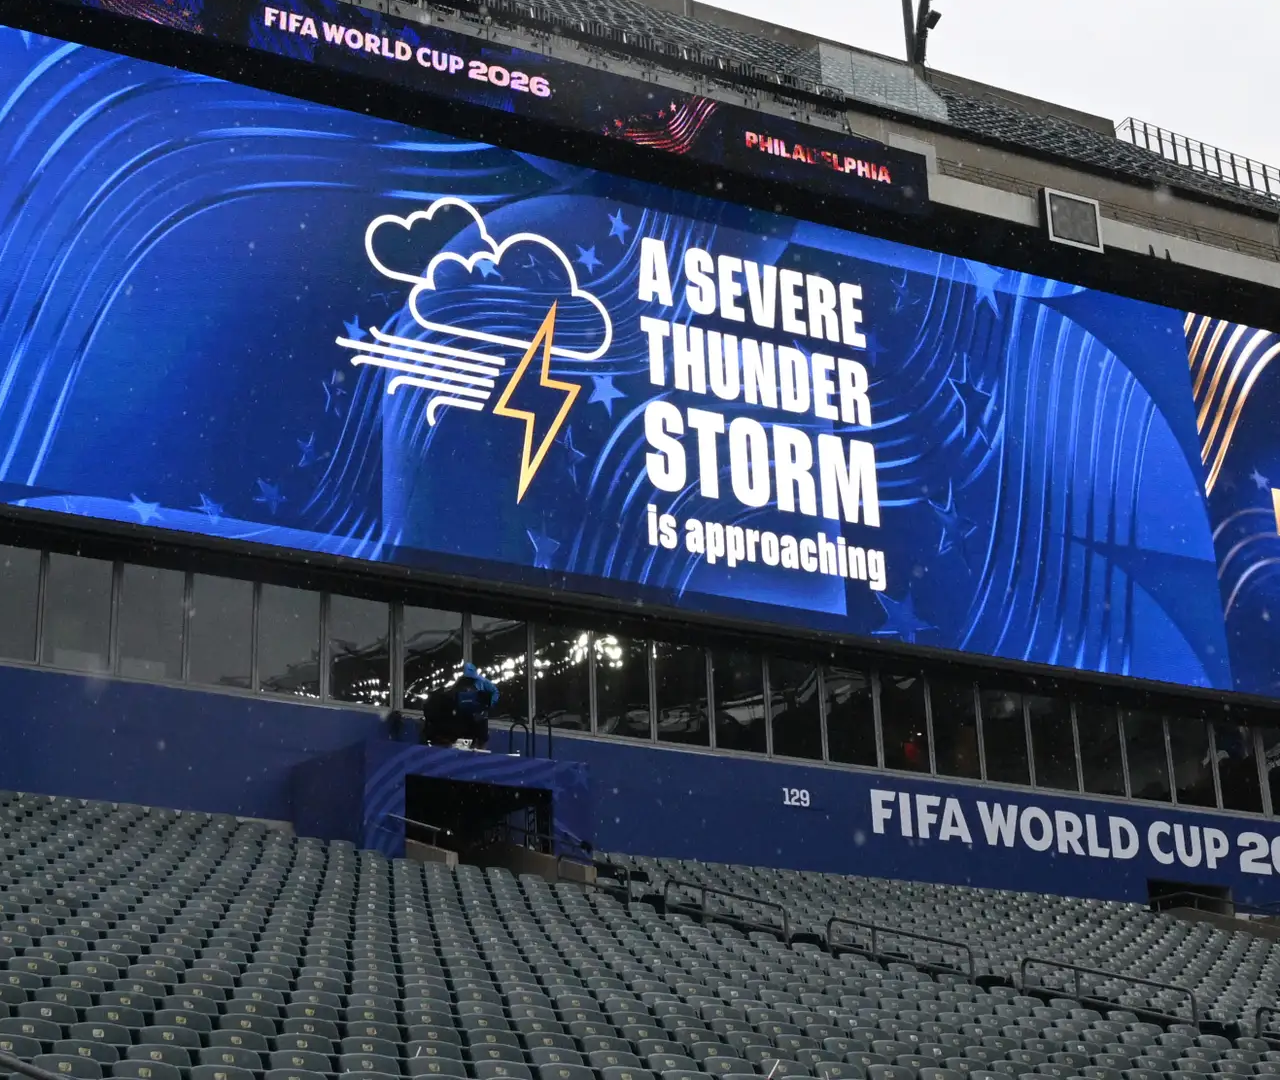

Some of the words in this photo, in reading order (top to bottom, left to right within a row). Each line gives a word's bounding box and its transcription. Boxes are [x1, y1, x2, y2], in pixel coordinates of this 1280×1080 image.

[264, 6, 319, 39] FIFA
[322, 21, 413, 61] WORLD
[415, 47, 465, 74] CUP
[468, 60, 551, 97] 2026
[745, 131, 892, 184] PHILADELPHIA
[637, 236, 674, 307] A
[684, 247, 867, 349] SEVERE
[640, 315, 873, 428] THUNDER
[644, 400, 881, 528] STORM
[647, 503, 678, 549] is
[685, 518, 887, 592] approaching
[782, 787, 811, 807] 129
[870, 788, 973, 844] FIFA
[976, 800, 1140, 859] WORLD
[1147, 820, 1229, 870] CUP
